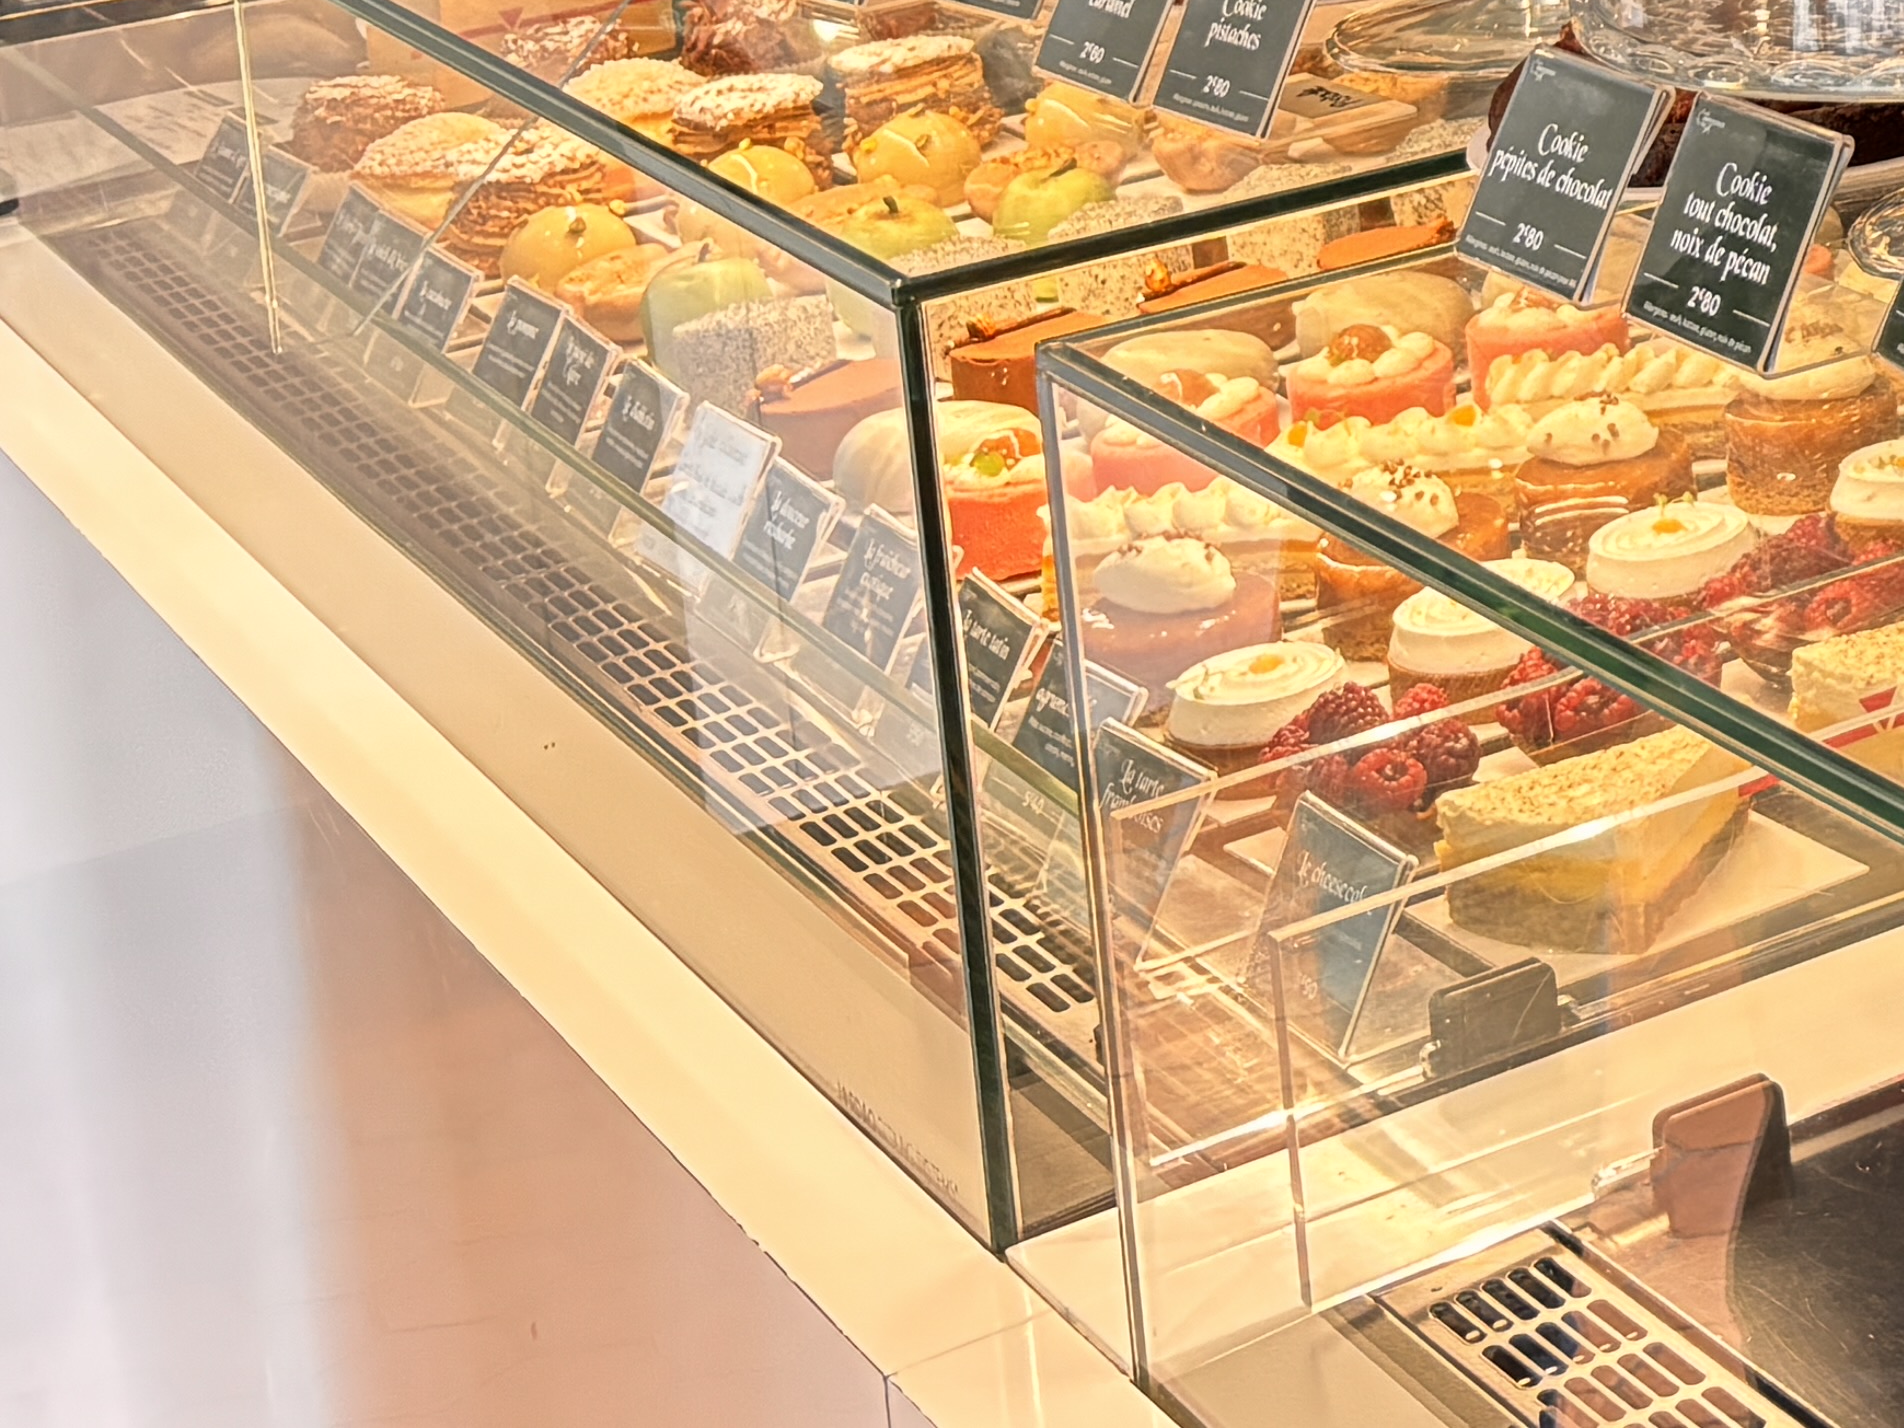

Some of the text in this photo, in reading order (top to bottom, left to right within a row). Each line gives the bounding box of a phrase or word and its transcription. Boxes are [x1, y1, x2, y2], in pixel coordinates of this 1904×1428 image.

[1537, 122, 1590, 163] Cookie
[1488, 145, 1615, 211] pépites de chocolat
[1715, 162, 1773, 206] Cookie
[1683, 191, 1779, 253] tout chocolat,
[1669, 227, 1772, 286] noix de pécan
[1118, 758, 1137, 795] La
